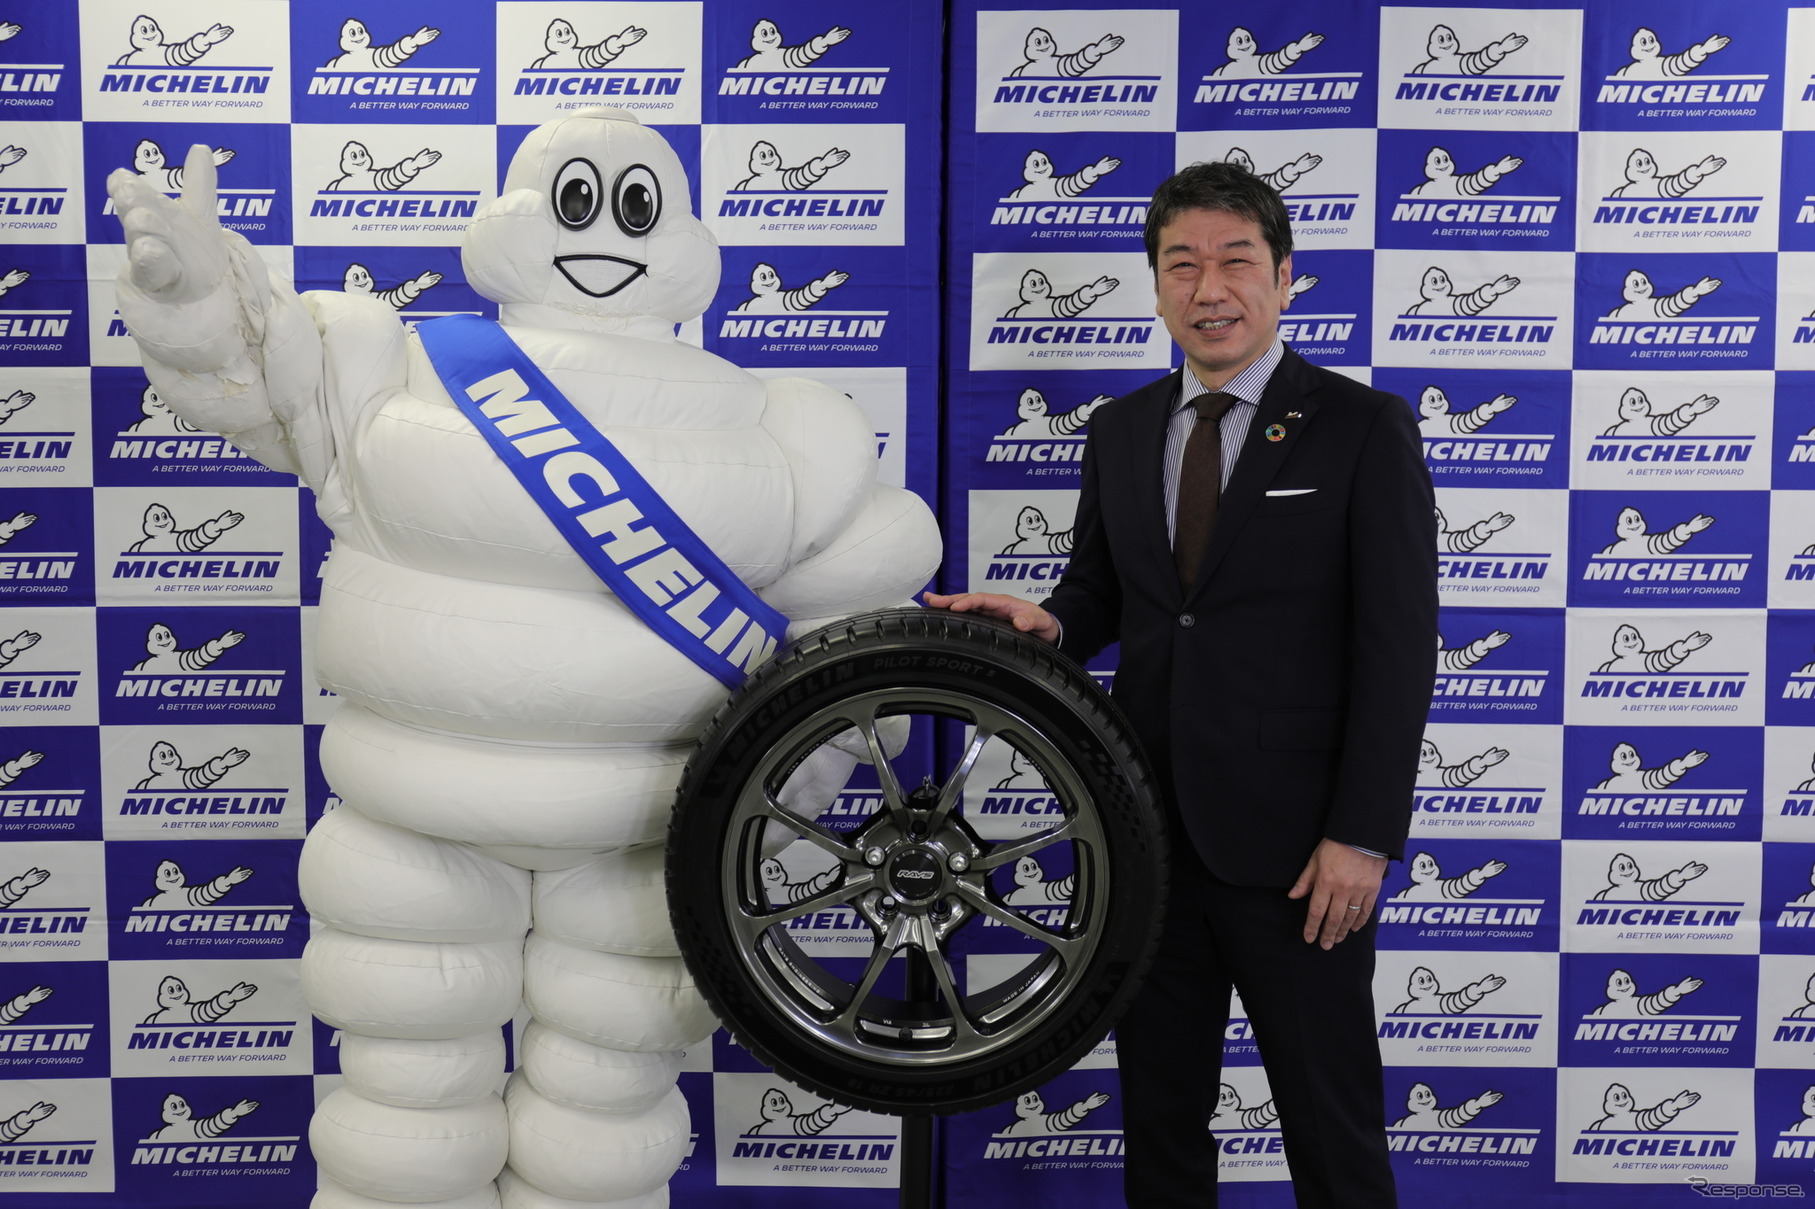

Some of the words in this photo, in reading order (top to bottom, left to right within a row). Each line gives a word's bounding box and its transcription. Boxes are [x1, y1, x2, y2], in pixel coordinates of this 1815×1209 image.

[99, 74, 270, 94] MICHELIN
[307, 77, 477, 96] MICHELIN
[514, 77, 682, 95] MICHELIN
[718, 77, 886, 95] MICHELIN
[1193, 82, 1359, 103] MICHELIN
[1395, 82, 1561, 102] MICHELIN
[993, 85, 1158, 104] MICHELIN
[1596, 84, 1765, 104] MICHELIN
[310, 199, 478, 218] MICHELIN
[718, 199, 885, 217] MICHELIN
[1391, 203, 1557, 224] MICHELIN
[1593, 206, 1760, 224] MICHELIN
[1301, 227, 1348, 235] FORWARD
[719, 319, 886, 338] MICHELIN
[987, 326, 1152, 344] MICHELIN
[1389, 324, 1554, 343] MICHELIN
[1589, 326, 1756, 344] MICHELIN
[110, 441, 249, 458] MICHEL
[1423, 442, 1551, 461] ICHELIN
[1586, 444, 1752, 462] MICHELIN
[465, 368, 778, 676] MICHELIN
[112, 560, 280, 578] MICHELIN
[1583, 563, 1749, 581] MICHELIN
[874, 656, 919, 670] PILOT
[925, 657, 983, 677] SPORT
[115, 679, 283, 697] MICHELIN
[1581, 681, 1746, 698] MICHELIN
[727, 663, 855, 760] MICHELIN
[119, 797, 286, 815] MICHELIN
[1412, 795, 1543, 813] ICHELIN
[1578, 798, 1744, 816] MICHELIN
[897, 870, 934, 879] RAYS
[124, 914, 291, 932] MICHELIN
[1378, 907, 1541, 925] MICHELIN
[1576, 909, 1741, 926] MICHELIN
[127, 1030, 294, 1049] MICHELIN
[1377, 1022, 1539, 1040] MICHELIN
[1574, 1023, 1738, 1041] MICHELIN
[131, 1145, 297, 1165] MICHELIN
[732, 1142, 894, 1161] MICHELIN
[1572, 1138, 1736, 1157] MICHELIN
[0, 1149, 94, 1165] HELIN
[841, 1166, 888, 1174] FORWARD
